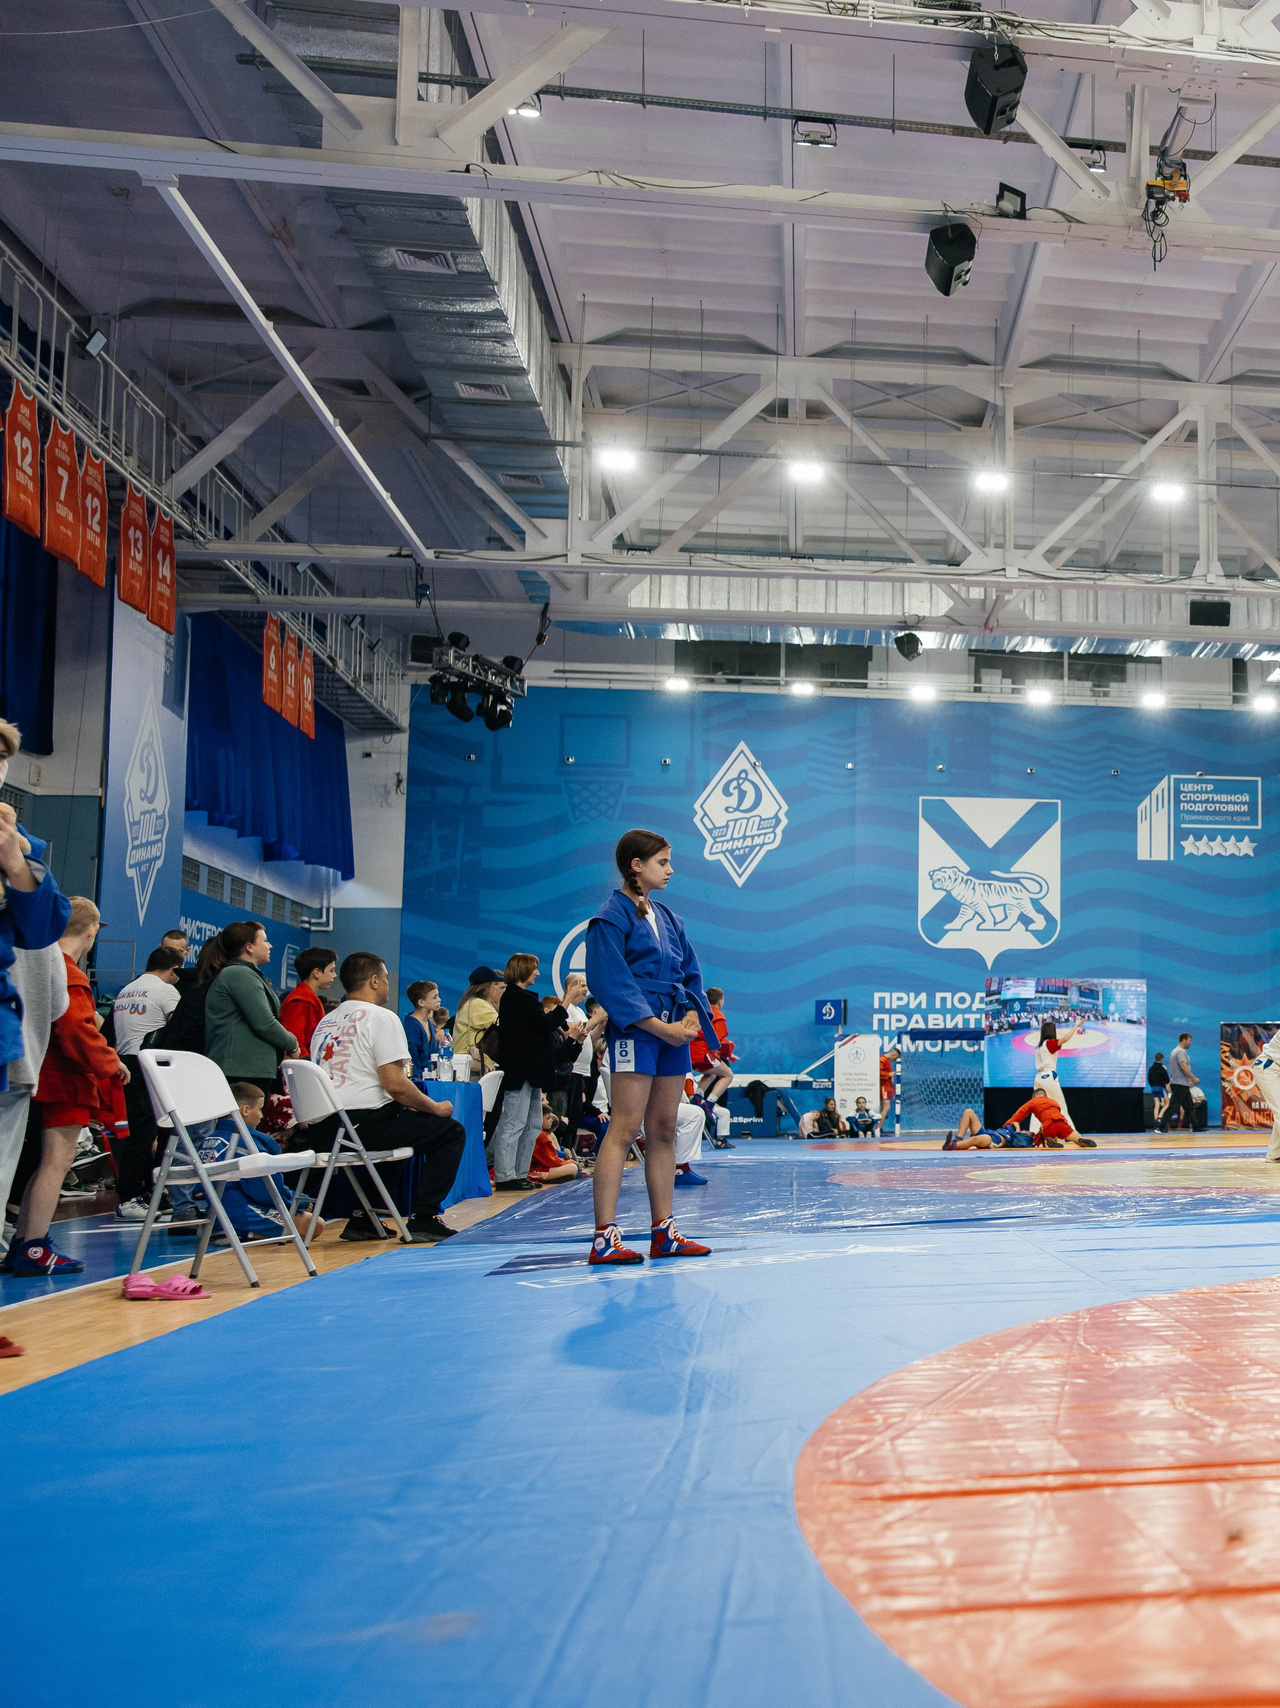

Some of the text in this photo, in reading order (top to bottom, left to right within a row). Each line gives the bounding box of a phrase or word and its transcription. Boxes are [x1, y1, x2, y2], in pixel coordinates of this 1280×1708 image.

[14, 431, 33, 476] 12
[57, 466, 69, 502] 7
[85, 493, 101, 532] 12
[128, 525, 143, 562] 13
[156, 549, 171, 584] 14
[269, 645, 276, 670] 6
[1180, 783, 1214, 792] ЦЕНТР
[1180, 793, 1250, 802] СПОРТИВНОЙ
[1180, 803, 1248, 812] ПОДГОТОВКИ
[1180, 813, 1231, 822] Приморского
[724, 816, 762, 839] 100
[760, 818, 776, 829] 2023
[130, 842, 162, 864] ДИНАМО
[711, 833, 775, 854] ДИНАМО
[734, 848, 750, 856] ЛЕТ
[873, 992, 985, 1011] ПРИ ПОД
[872, 1014, 985, 1031] ПРАВИТ
[1251, 1101, 1260, 1109] НА
